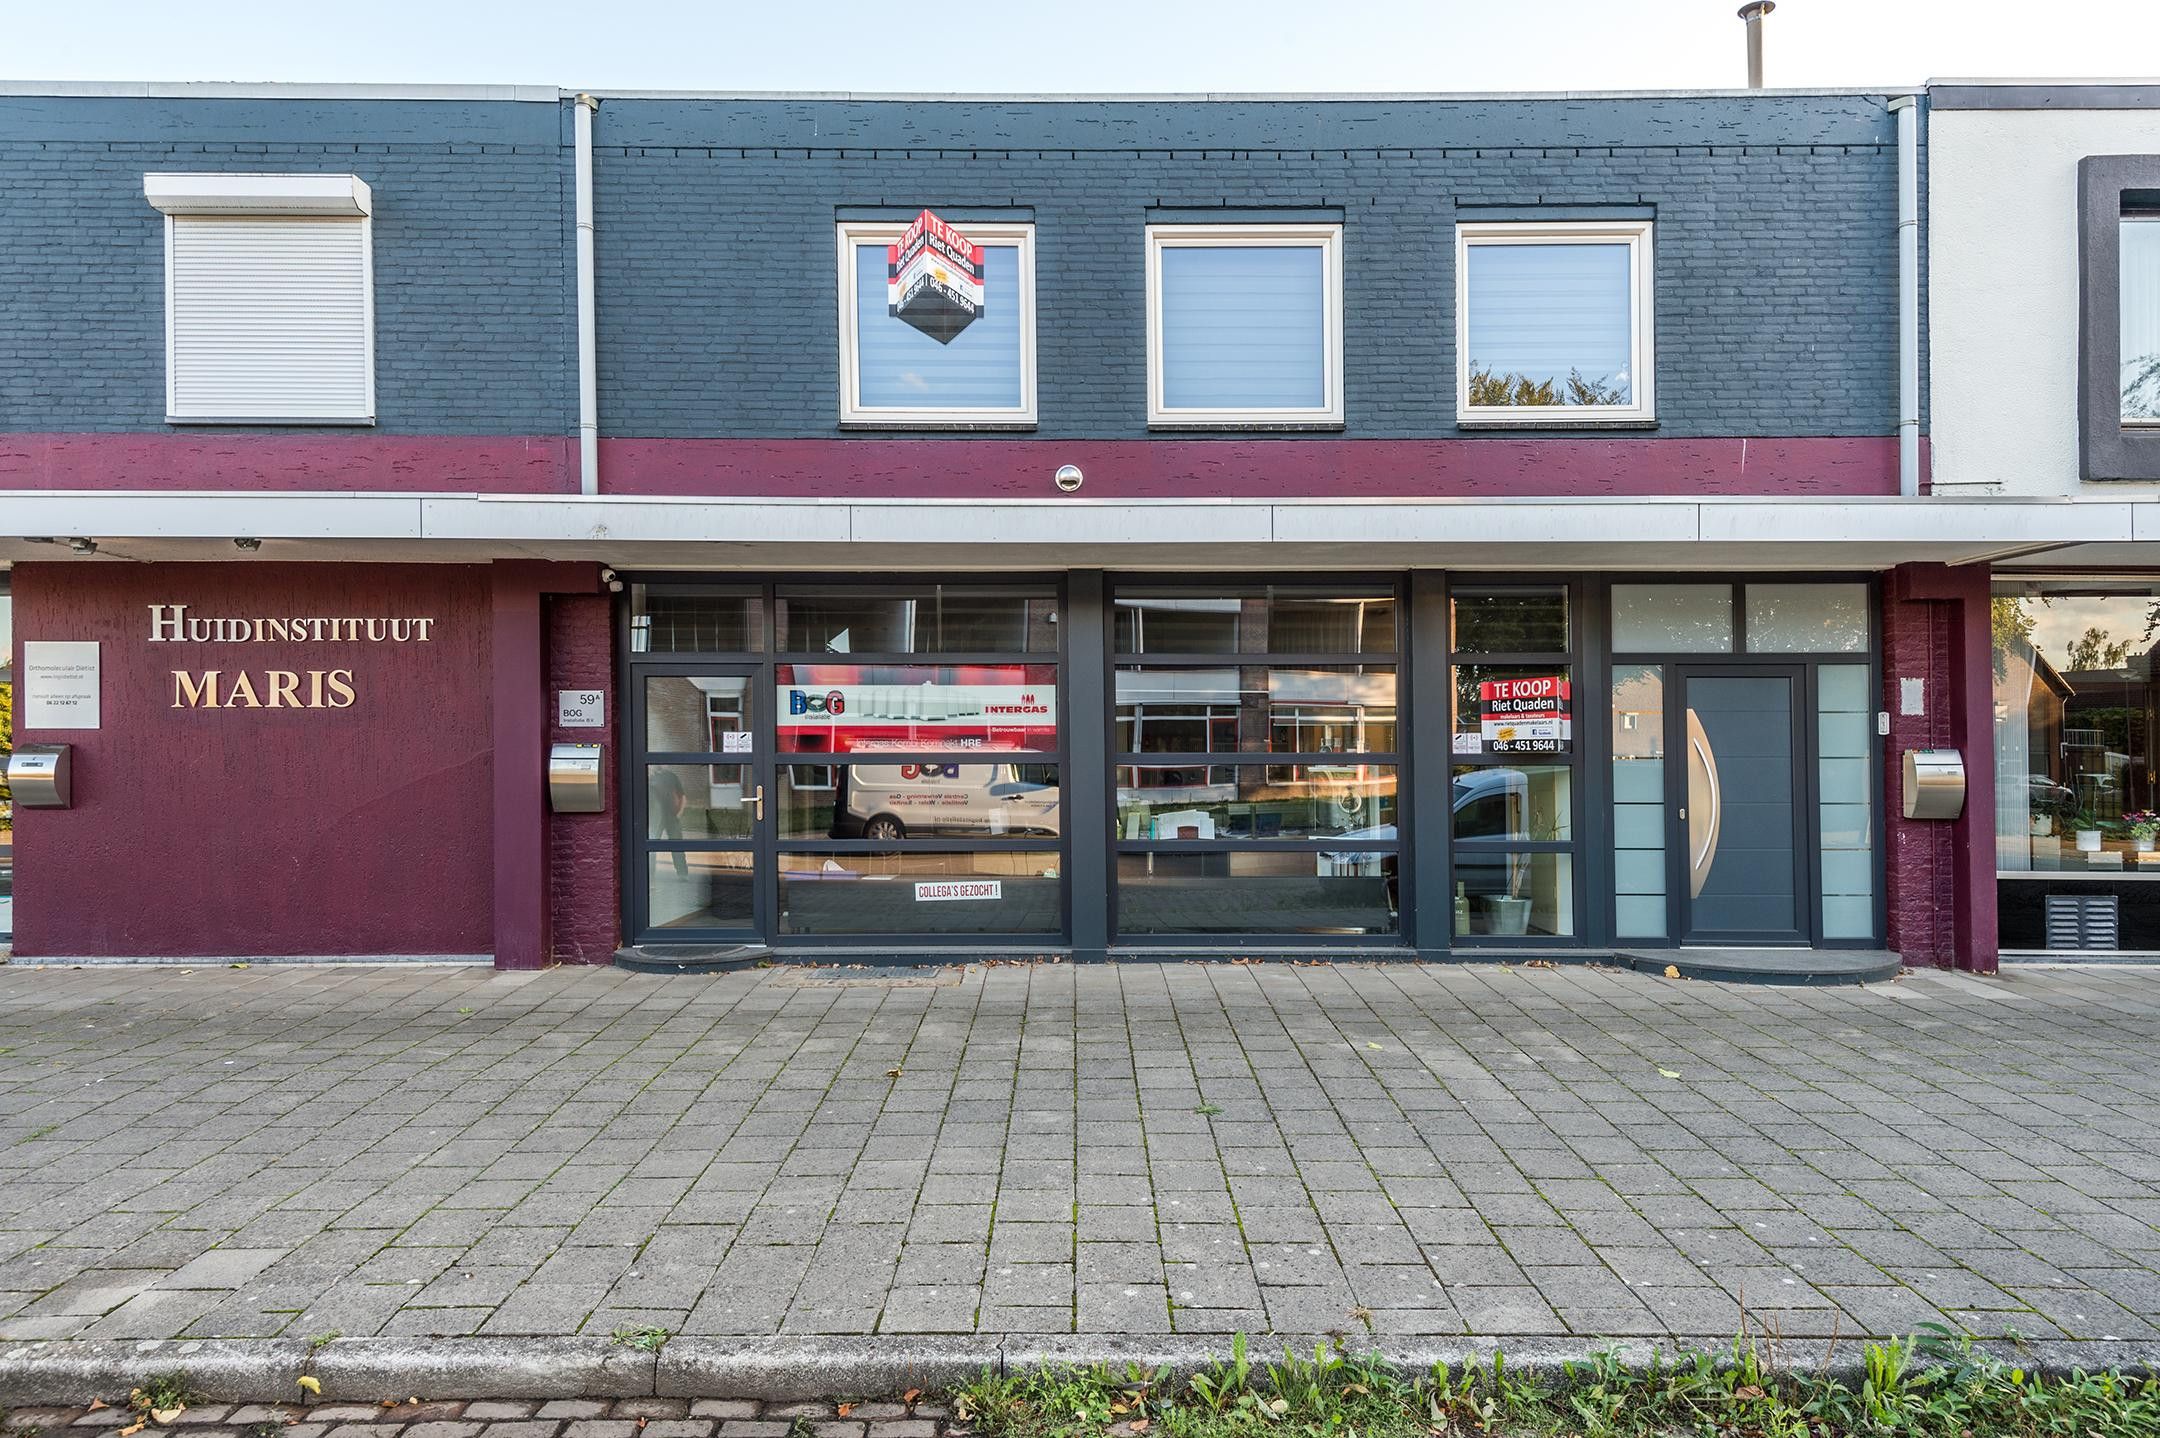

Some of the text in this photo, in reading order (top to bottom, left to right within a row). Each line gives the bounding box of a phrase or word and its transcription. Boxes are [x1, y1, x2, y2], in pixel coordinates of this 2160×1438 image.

[904, 217, 923, 251] KOOP
[930, 216, 973, 257] TE KOOP
[929, 233, 946, 254] Riet
[946, 246, 975, 274] Quaden
[170, 669, 356, 709] MARIS
[1493, 682, 1509, 698] TE
[1512, 680, 1551, 697] KOOP
[789, 690, 845, 715] BOG
[985, 705, 1048, 714] INTERGAS
[1492, 700, 1511, 712] Riet
[1513, 698, 1554, 712] Quaden
[563, 709, 583, 718] BOG
[960, 738, 982, 747] HRE
[1493, 740, 1508, 751] 046
[1515, 740, 1532, 750] 451
[1533, 740, 1555, 750] 9644
[919, 884, 959, 898] COLLEGA'S
[960, 884, 993, 897] GEZOCHT
